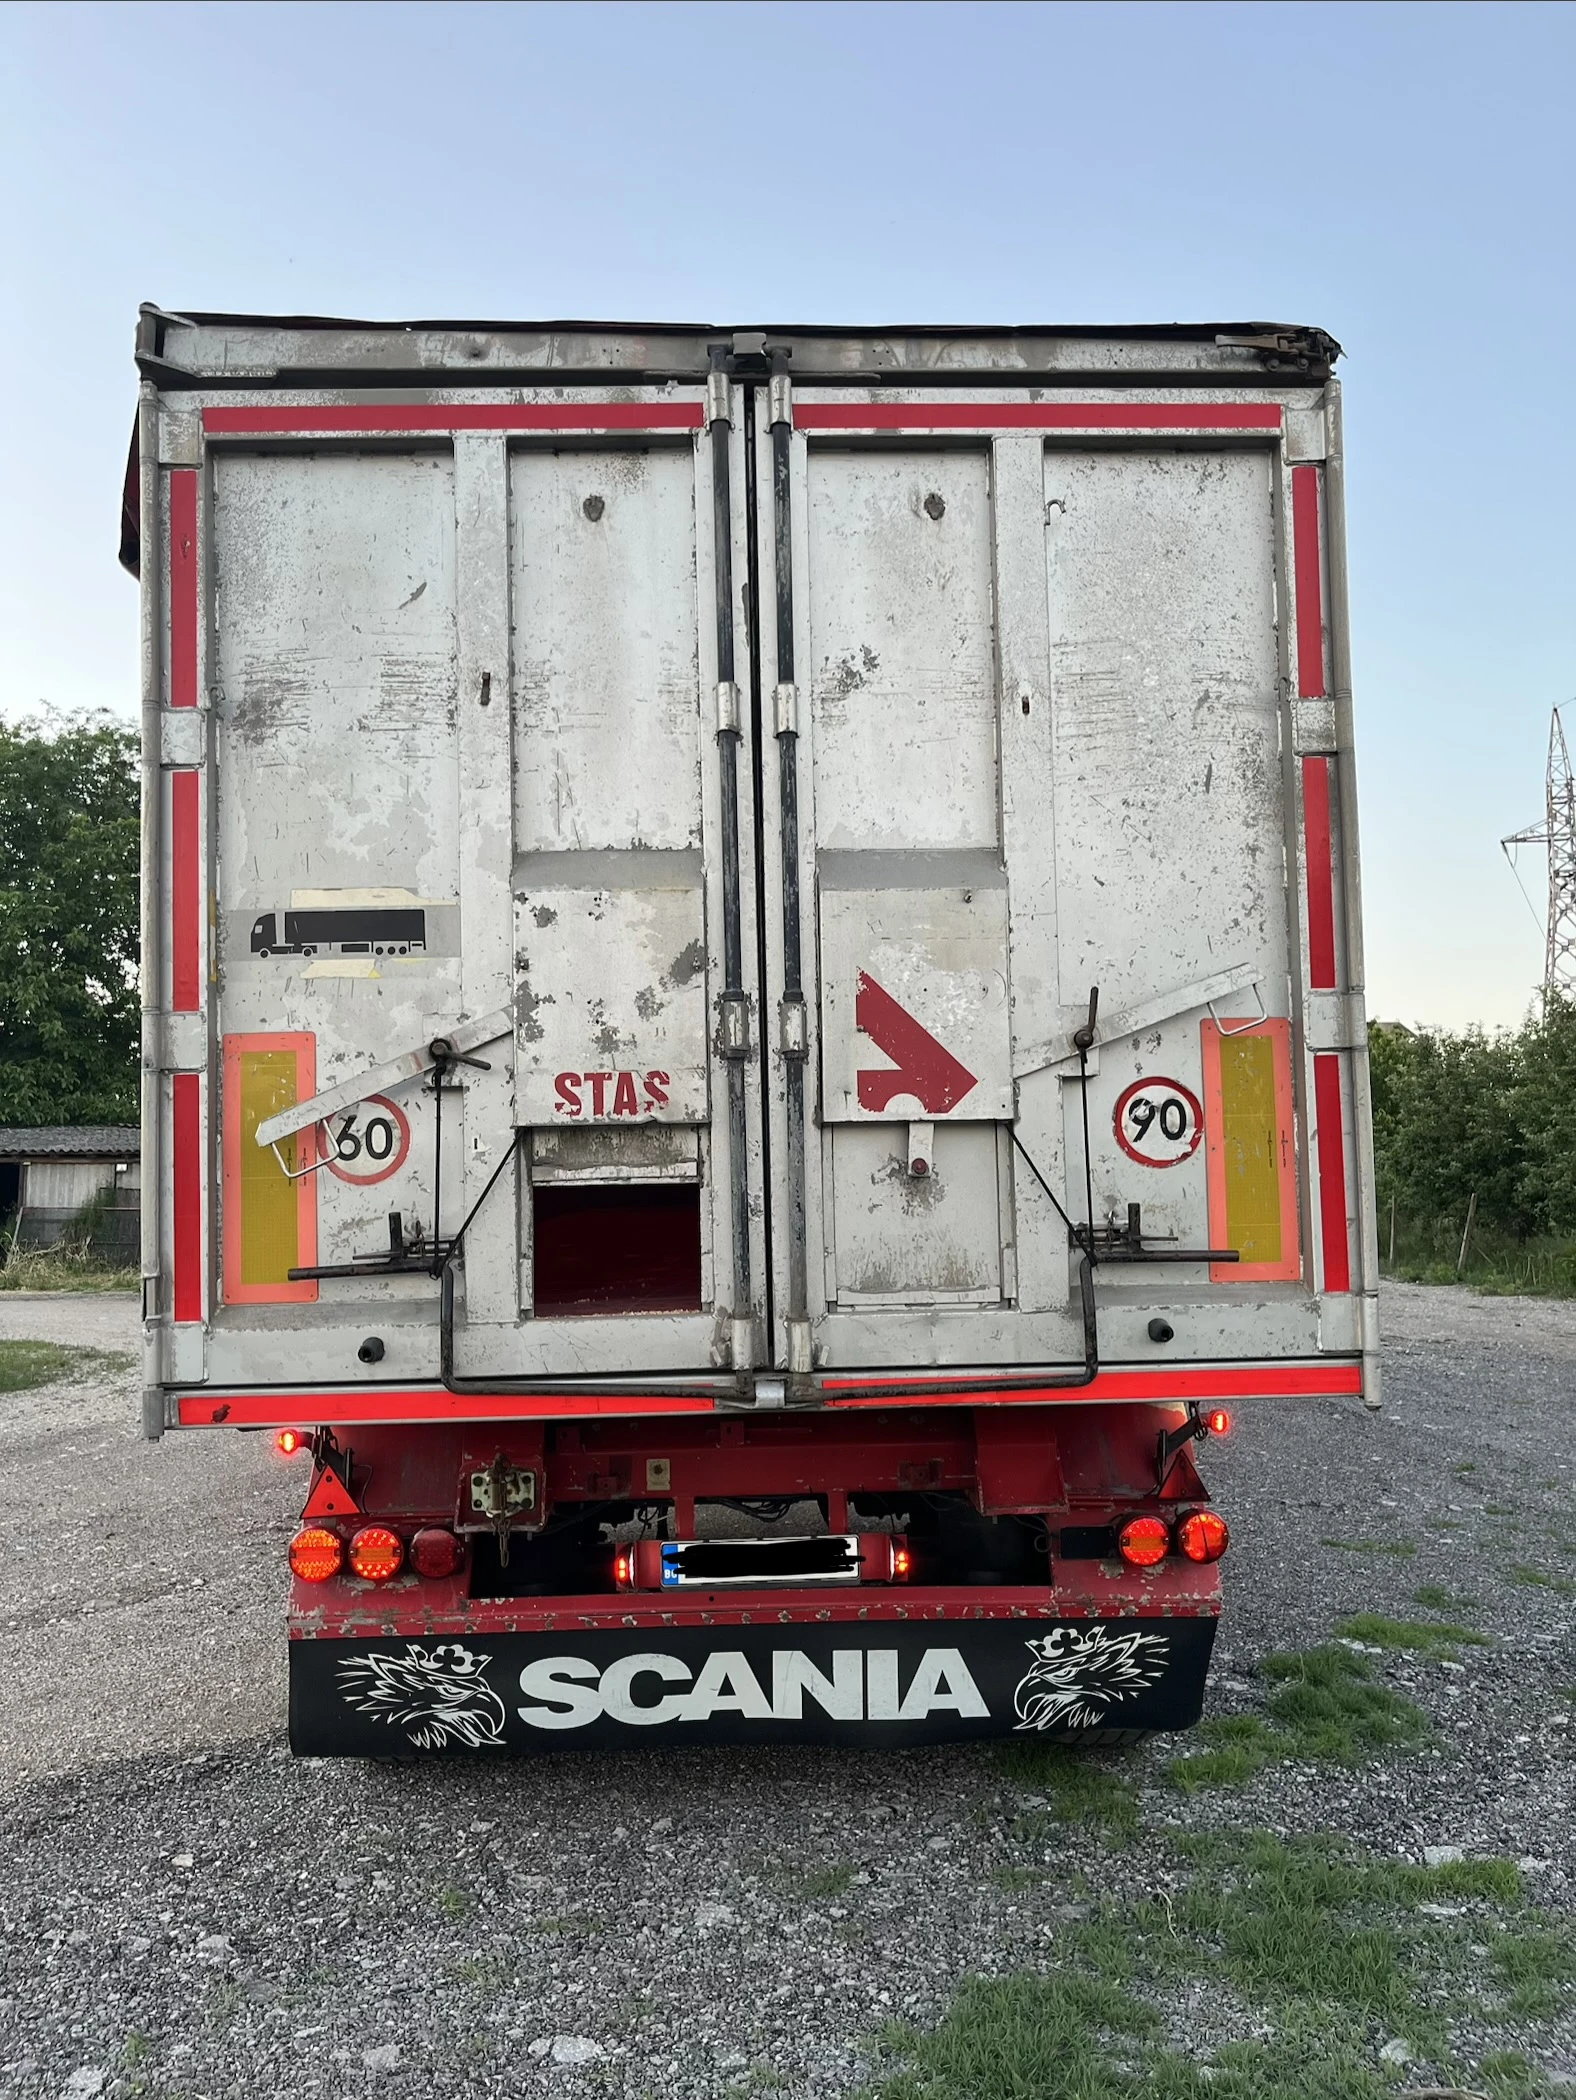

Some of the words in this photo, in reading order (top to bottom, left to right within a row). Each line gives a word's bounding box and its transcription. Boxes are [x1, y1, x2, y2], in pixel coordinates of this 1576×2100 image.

[554, 1070, 671, 1117] STAS
[335, 1114, 393, 1162] 60
[1128, 1098, 1187, 1143] 90
[517, 1648, 992, 1730] SCANIA
